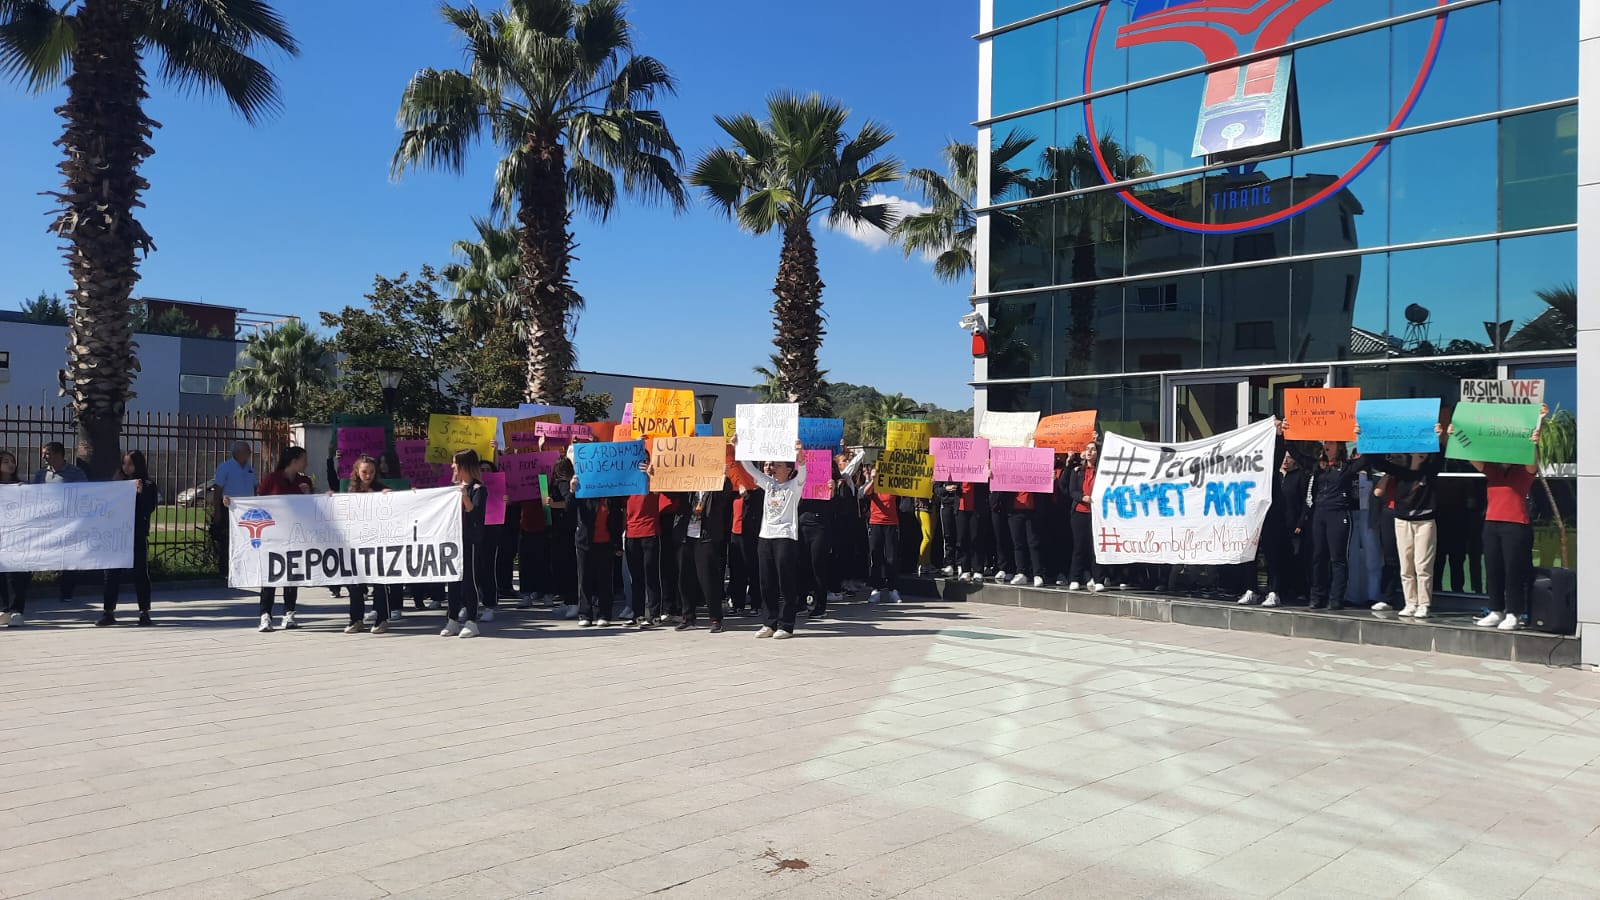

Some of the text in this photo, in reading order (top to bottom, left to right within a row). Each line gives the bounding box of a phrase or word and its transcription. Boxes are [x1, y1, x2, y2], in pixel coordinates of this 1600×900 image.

[1463, 380, 1542, 397] ARSIMI YNE
[577, 446, 587, 460] E
[590, 444, 644, 460] ARDHMJA
[878, 474, 922, 490] E KOMBIT
[314, 495, 374, 521] NENI
[1203, 481, 1257, 517] AKIF
[267, 542, 460, 583] DEPOLITIZUAR
